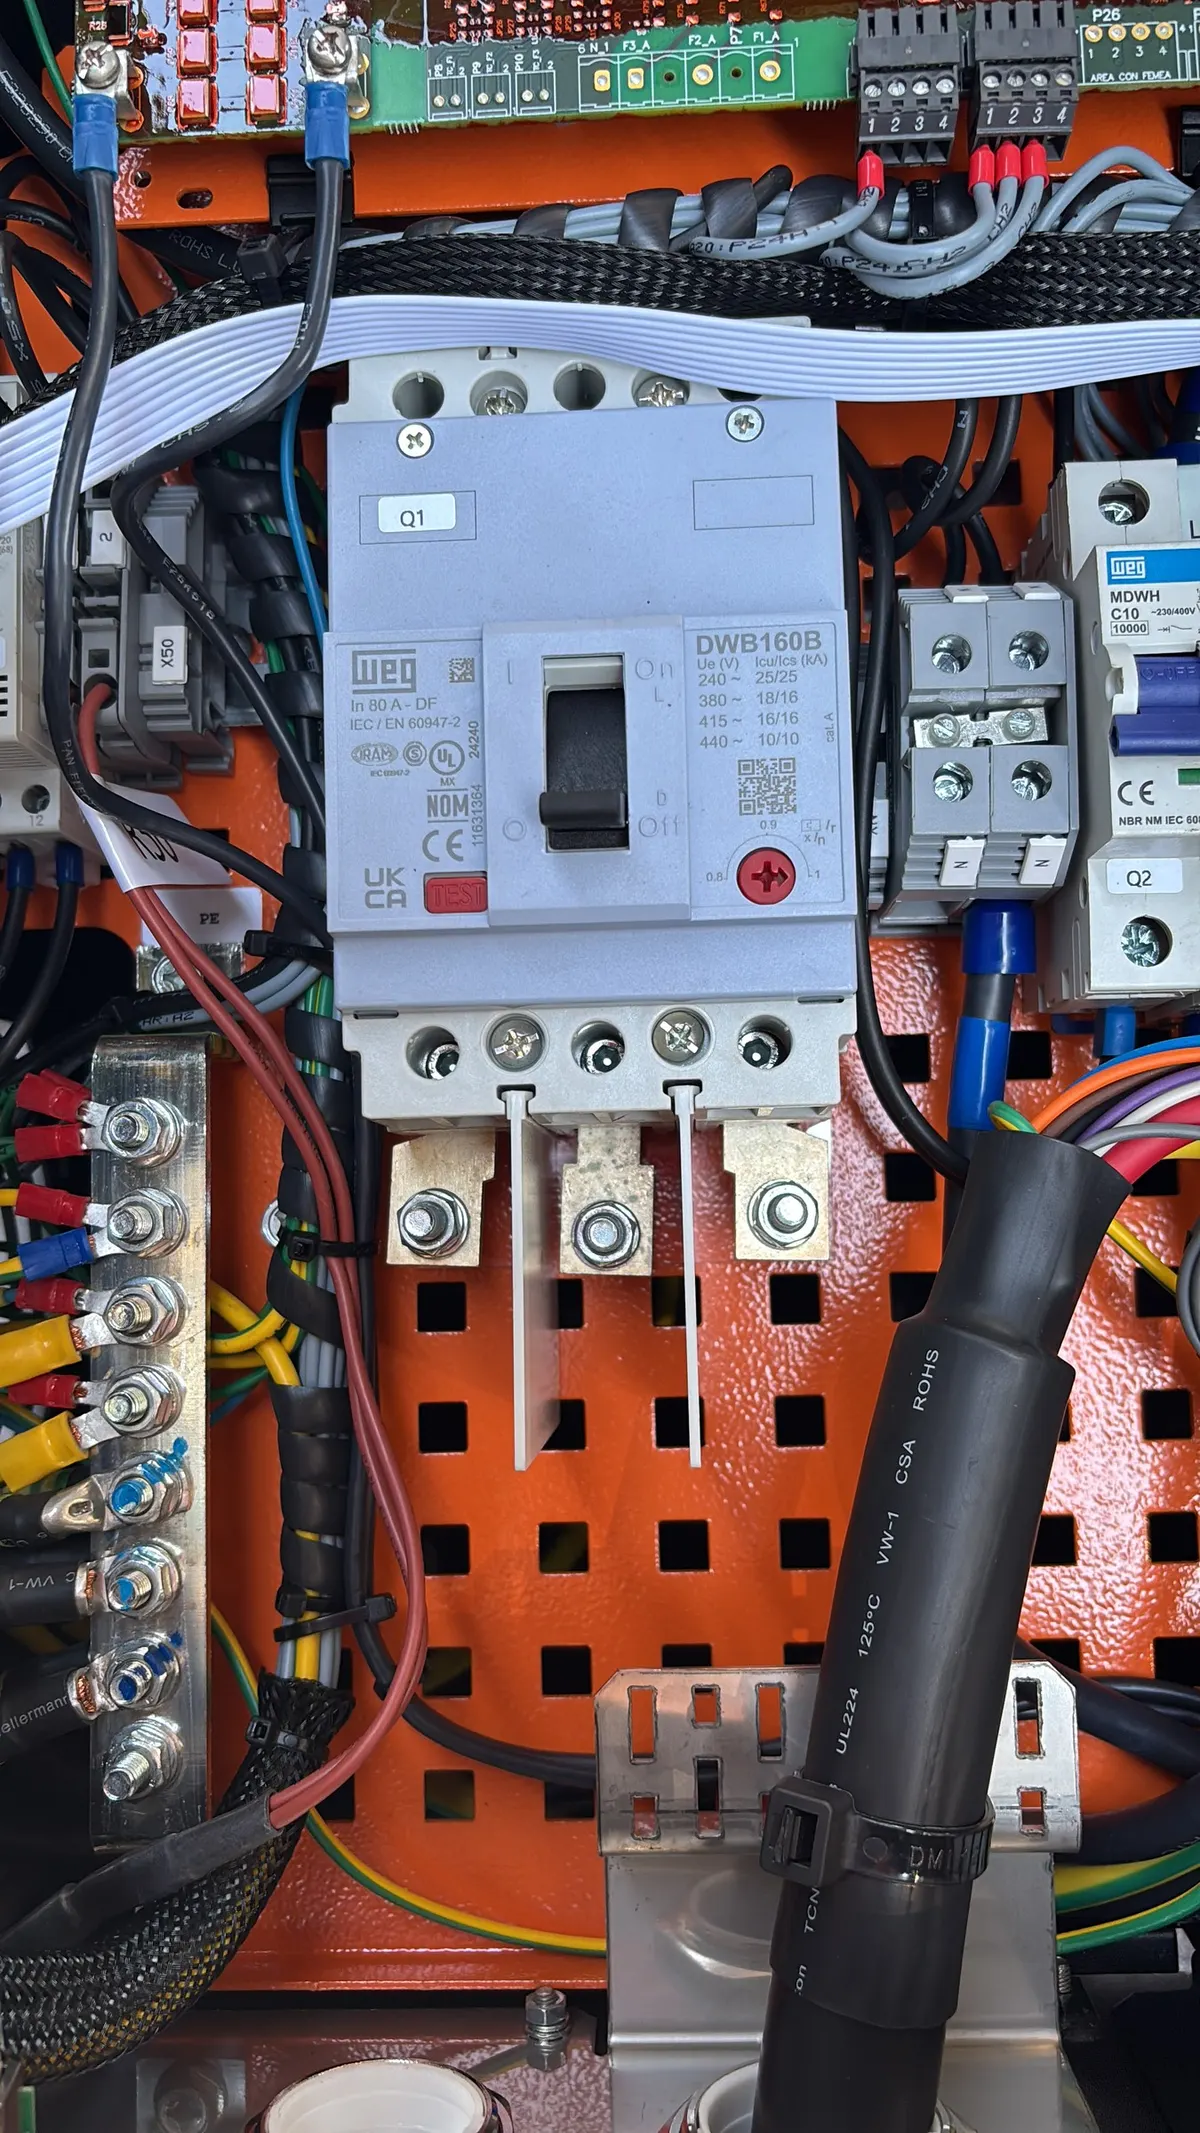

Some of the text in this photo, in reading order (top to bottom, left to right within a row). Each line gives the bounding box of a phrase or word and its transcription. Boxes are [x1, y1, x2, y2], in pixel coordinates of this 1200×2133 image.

[1092, 8, 1121, 22] P26
[688, 34, 716, 48] F2_A
[730, 26, 743, 44] P7
[753, 31, 780, 44] F1_A
[578, 43, 586, 54] 6
[622, 40, 651, 53] F3_A
[1088, 48, 1094, 59] 1
[1112, 47, 1120, 59] 2
[1135, 45, 1144, 57] 3
[1158, 45, 1168, 56] 4
[472, 61, 482, 74] P9
[502, 65, 510, 74] 2
[514, 53, 525, 71] P10
[547, 60, 554, 70] 2
[458, 66, 465, 76] 2
[1090, 72, 1115, 83] AREA
[1118, 71, 1139, 81] CON
[986, 106, 1067, 124] 1 2 3 4
[868, 115, 949, 133] 1 2 3 4
[400, 509, 424, 528] Q1
[99, 531, 113, 542] 2
[1109, 590, 1160, 604] MDWH
[1110, 607, 1140, 621] C10
[1112, 623, 1147, 634] 10000
[696, 630, 822, 656] DWB160B
[160, 638, 175, 669] X50
[635, 657, 674, 681] On
[697, 653, 828, 672] Ue (V) Icu/Ics (kA)
[698, 672, 727, 687] 240
[755, 669, 798, 685] 25/25
[351, 699, 364, 713] In
[368, 698, 387, 712] 80
[390, 698, 402, 712] A
[415, 696, 438, 711] DF
[698, 693, 727, 708] 380
[756, 689, 799, 705] 18/16
[350, 718, 374, 731] IEC
[385, 717, 405, 730] EN
[408, 715, 461, 730] 60947-2
[698, 714, 728, 728] 415
[757, 711, 799, 726] 16/16
[468, 720, 480, 759] 24240
[699, 734, 729, 749] 440
[758, 731, 800, 747] 10/10
[1117, 779, 1155, 807] CE
[426, 794, 469, 818] NOM
[28, 813, 44, 827] 12
[471, 783, 484, 847] 11631364
[1119, 816, 1143, 826] NBR
[1145, 815, 1163, 826] NM
[1164, 815, 1184, 825] IEC
[759, 819, 777, 830] 0.9
[422, 828, 465, 863] CE
[364, 867, 406, 887] UK
[706, 871, 723, 882] 0.8
[1126, 870, 1153, 888] Q2
[364, 889, 407, 909] CA
[431, 882, 486, 908] TEST
[199, 912, 221, 926] PE
[835, 1687, 859, 1755] UL224
[876, 1510, 900, 1566] VW-1
[895, 1438, 917, 1485] CSA
[912, 1348, 940, 1412] ROHS
[8, 1575, 55, 1591] VW-1
